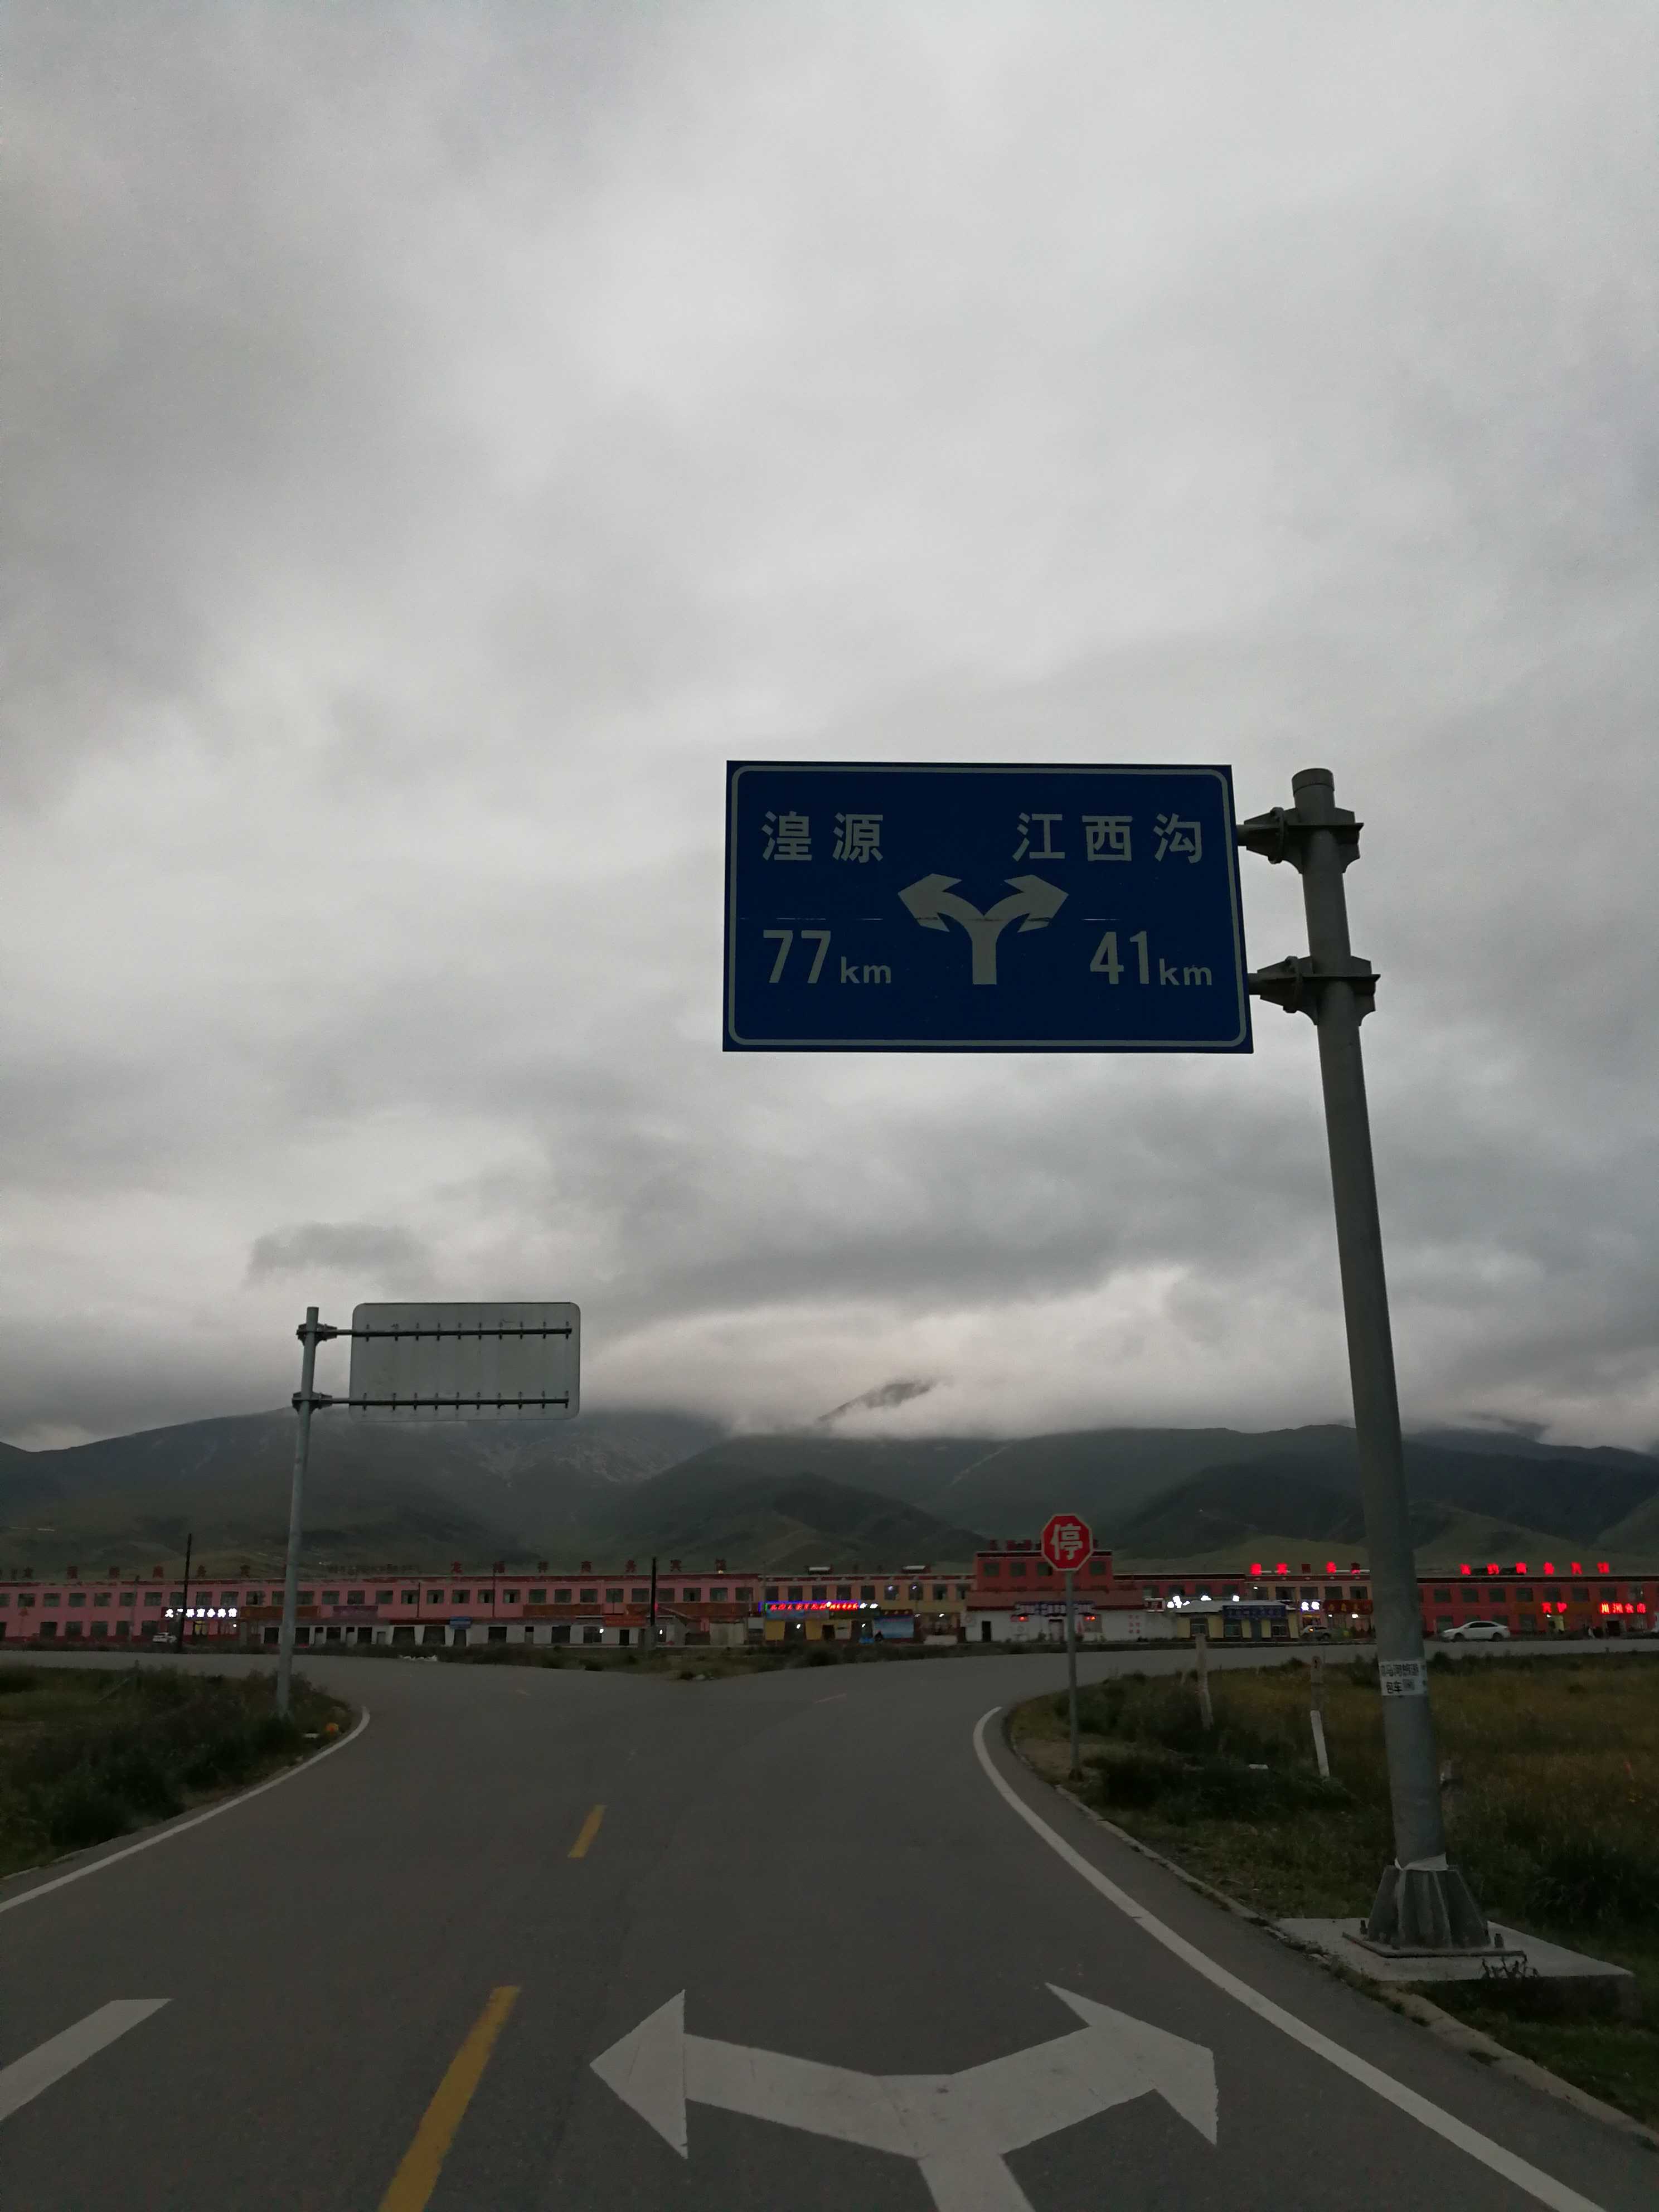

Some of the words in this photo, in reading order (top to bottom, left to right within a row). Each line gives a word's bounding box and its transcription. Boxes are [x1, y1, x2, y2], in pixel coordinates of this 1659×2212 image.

[762, 811, 884, 863] 湟源
[1012, 813, 1202, 864] 江西沟
[1050, 1523, 1083, 1560] 停
